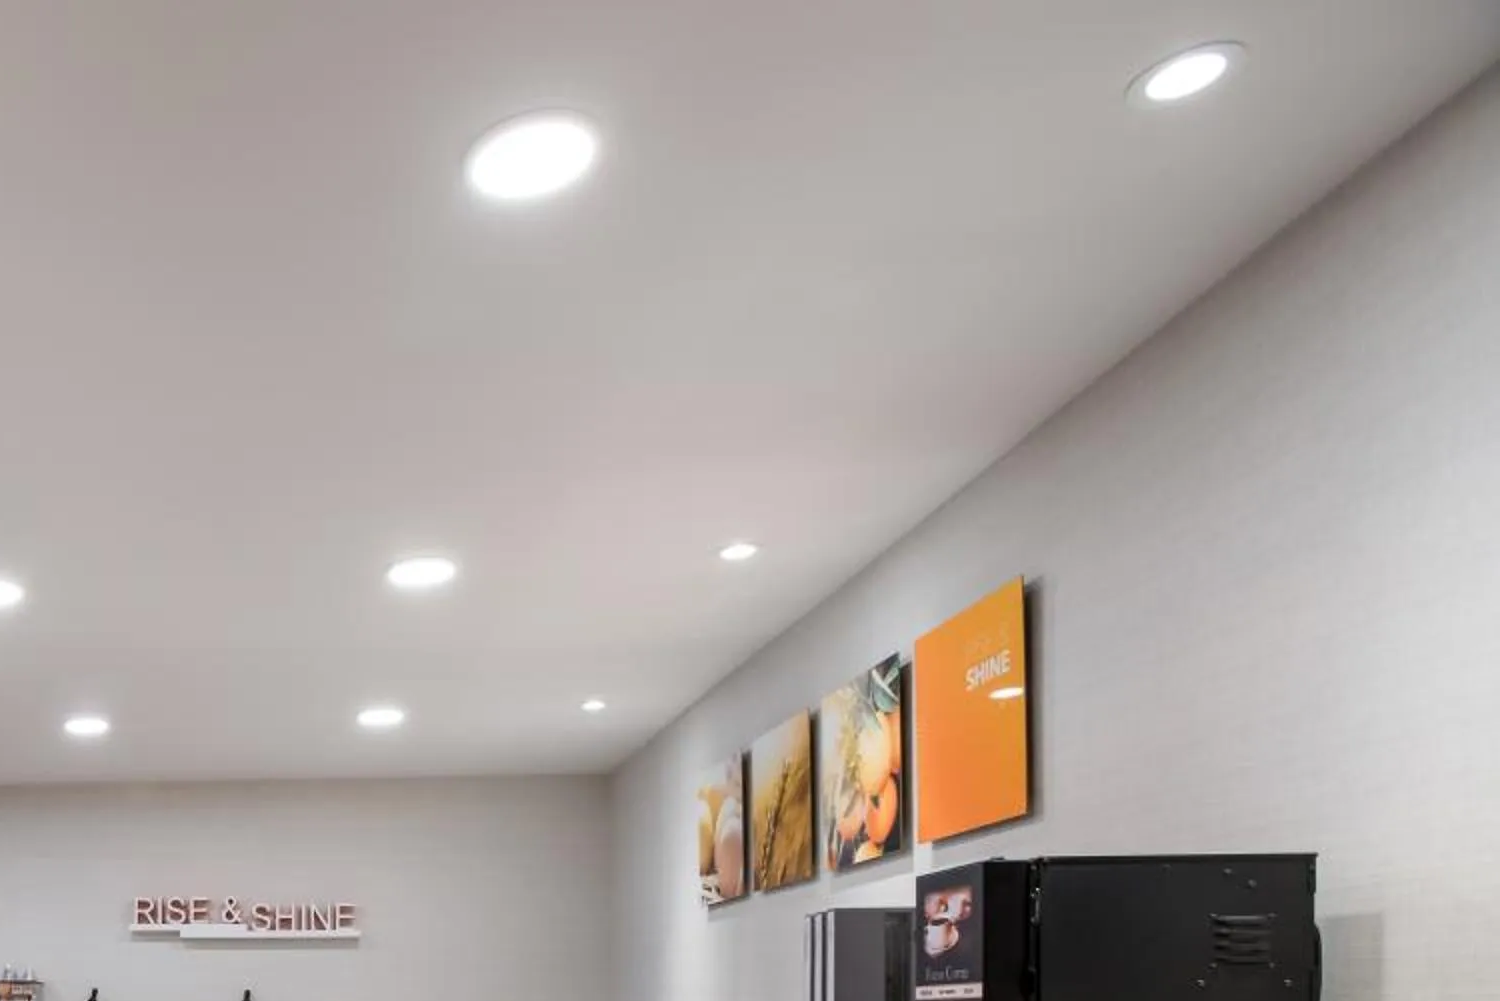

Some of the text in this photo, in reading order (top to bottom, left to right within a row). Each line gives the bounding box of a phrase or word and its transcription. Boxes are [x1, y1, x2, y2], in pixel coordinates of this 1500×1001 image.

[965, 649, 1011, 692] SHINE
[134, 896, 357, 932] RISE & SHINE
